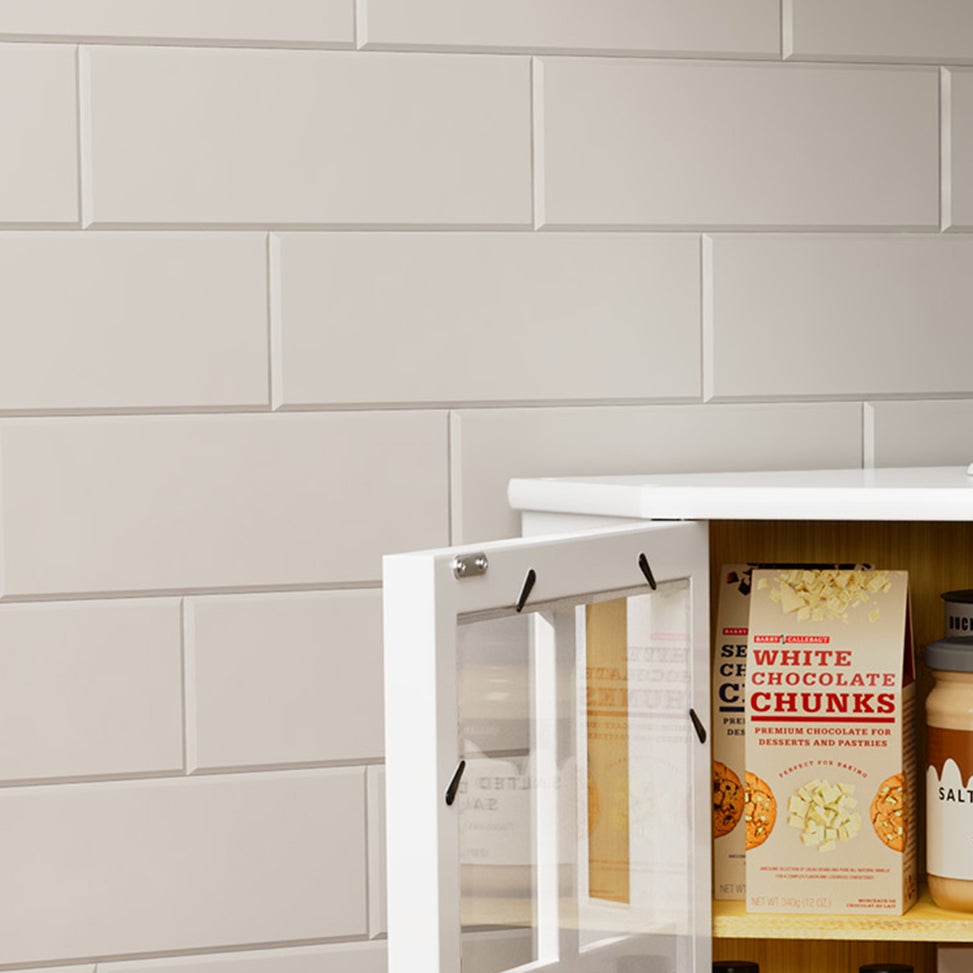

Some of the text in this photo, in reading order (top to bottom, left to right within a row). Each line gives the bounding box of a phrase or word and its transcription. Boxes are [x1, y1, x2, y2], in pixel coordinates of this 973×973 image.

[753, 650, 852, 667] WHITE
[751, 672, 896, 687] CHOCOLATE
[750, 691, 896, 715] CHUNKS
[754, 726, 892, 736] PREMIUM CHOCOLATE FOR
[758, 738, 888, 748] DESSERTS AND PASTRIES
[779, 760, 814, 778] PERFECT
